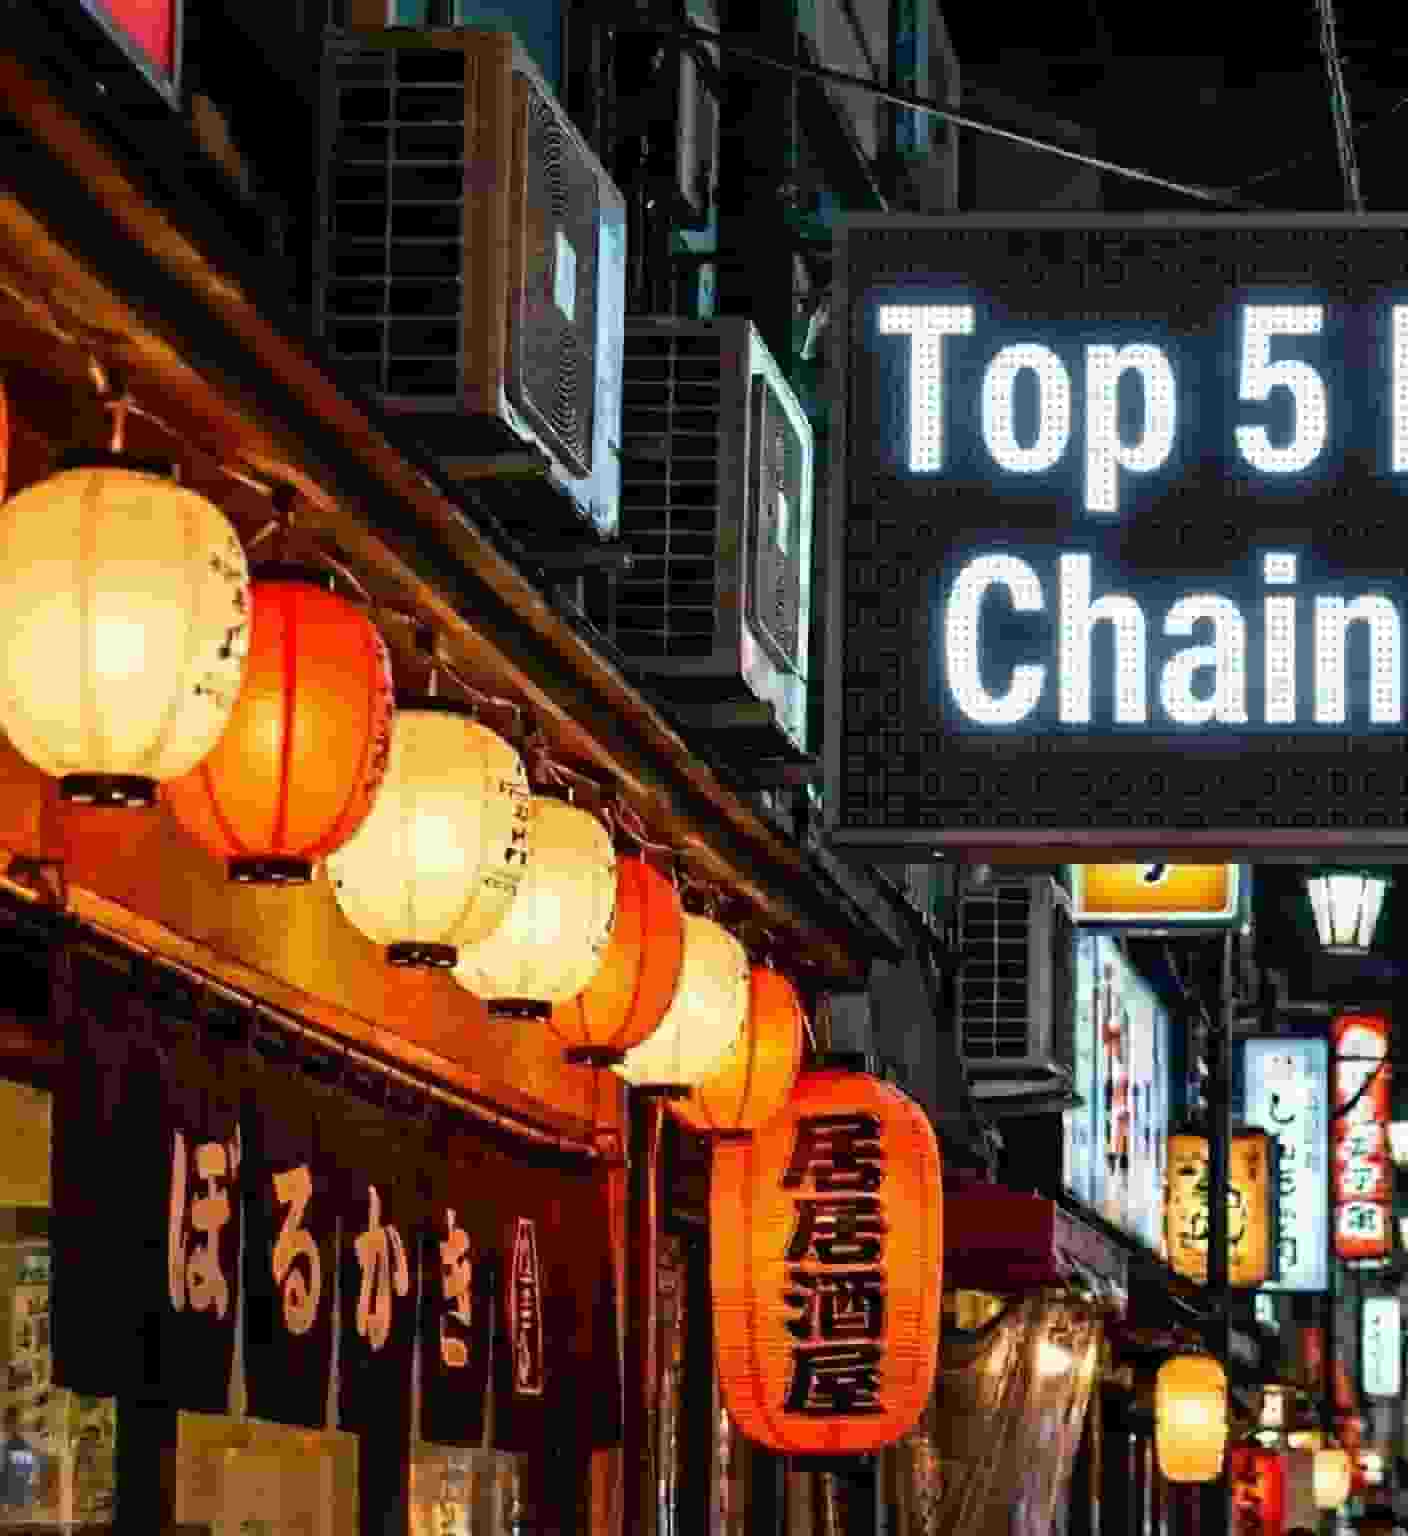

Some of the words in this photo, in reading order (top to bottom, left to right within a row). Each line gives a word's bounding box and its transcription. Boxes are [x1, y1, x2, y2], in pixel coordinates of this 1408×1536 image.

[880, 306, 1176, 512] Top
[1236, 306, 1327, 472] 5
[944, 554, 1400, 723] Chain
